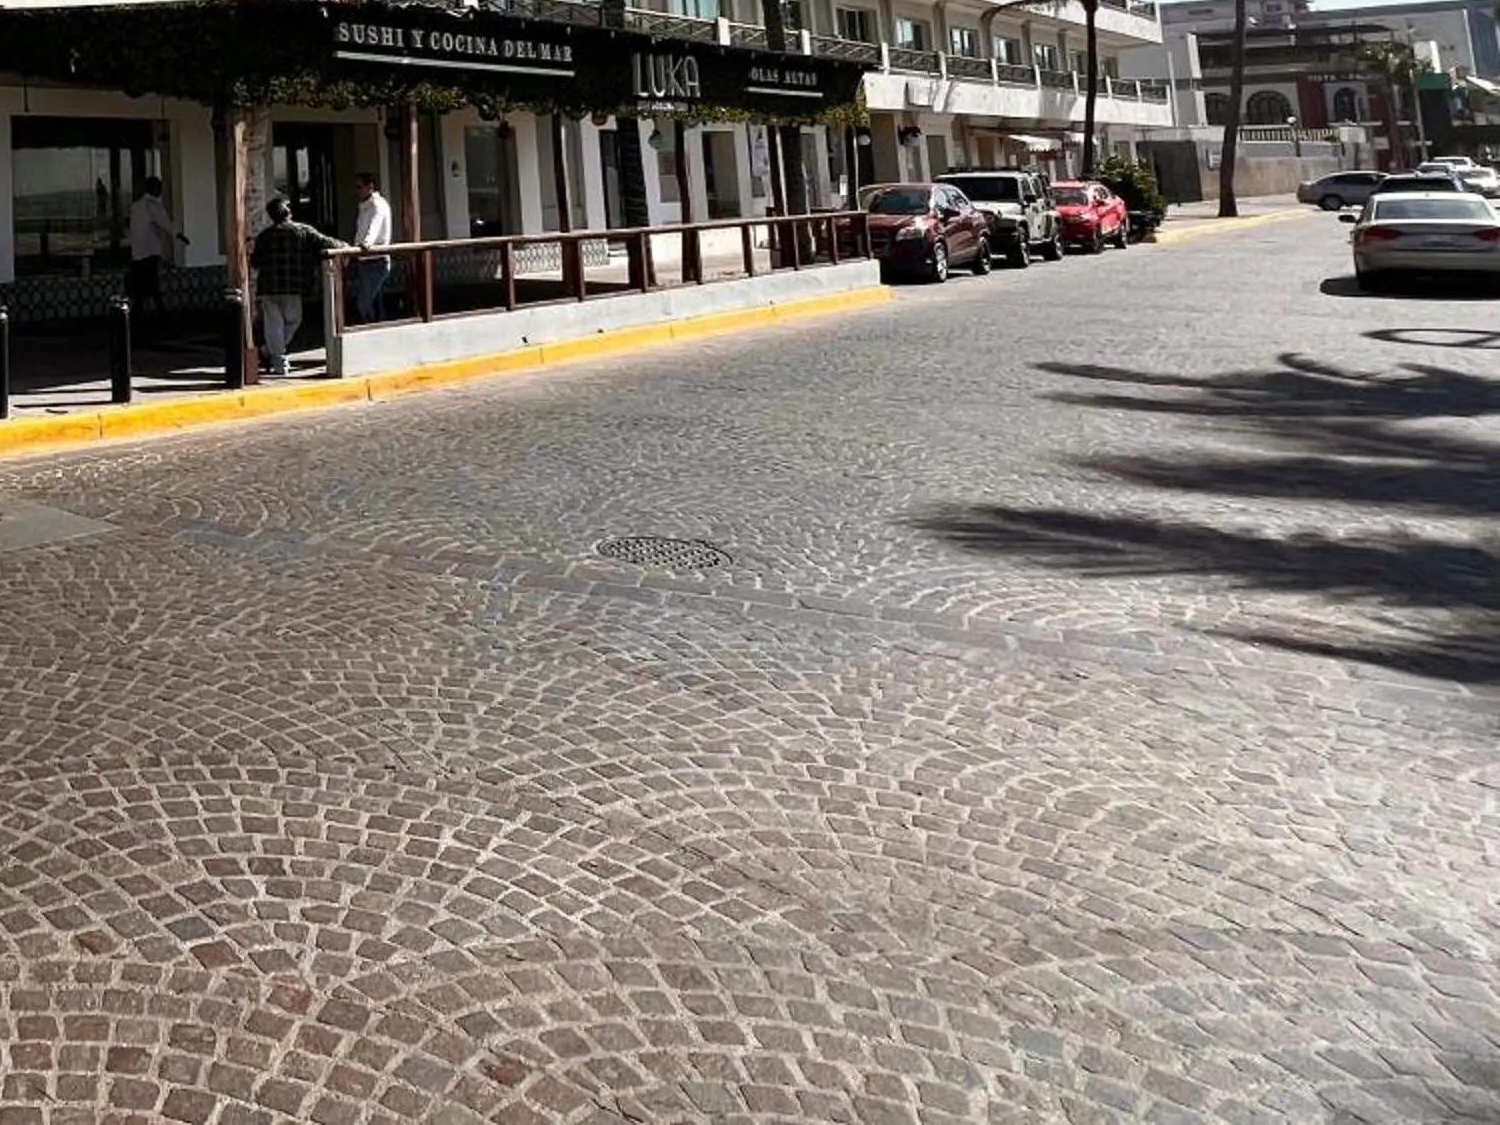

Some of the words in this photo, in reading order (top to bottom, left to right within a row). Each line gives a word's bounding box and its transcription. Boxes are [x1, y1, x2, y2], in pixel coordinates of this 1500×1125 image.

[337, 22, 404, 47] SUSHI
[411, 29, 426, 48] Y
[429, 31, 498, 56] COCINA
[503, 39, 537, 59] DEL
[540, 42, 573, 62] MAR
[631, 52, 700, 97] LUKA
